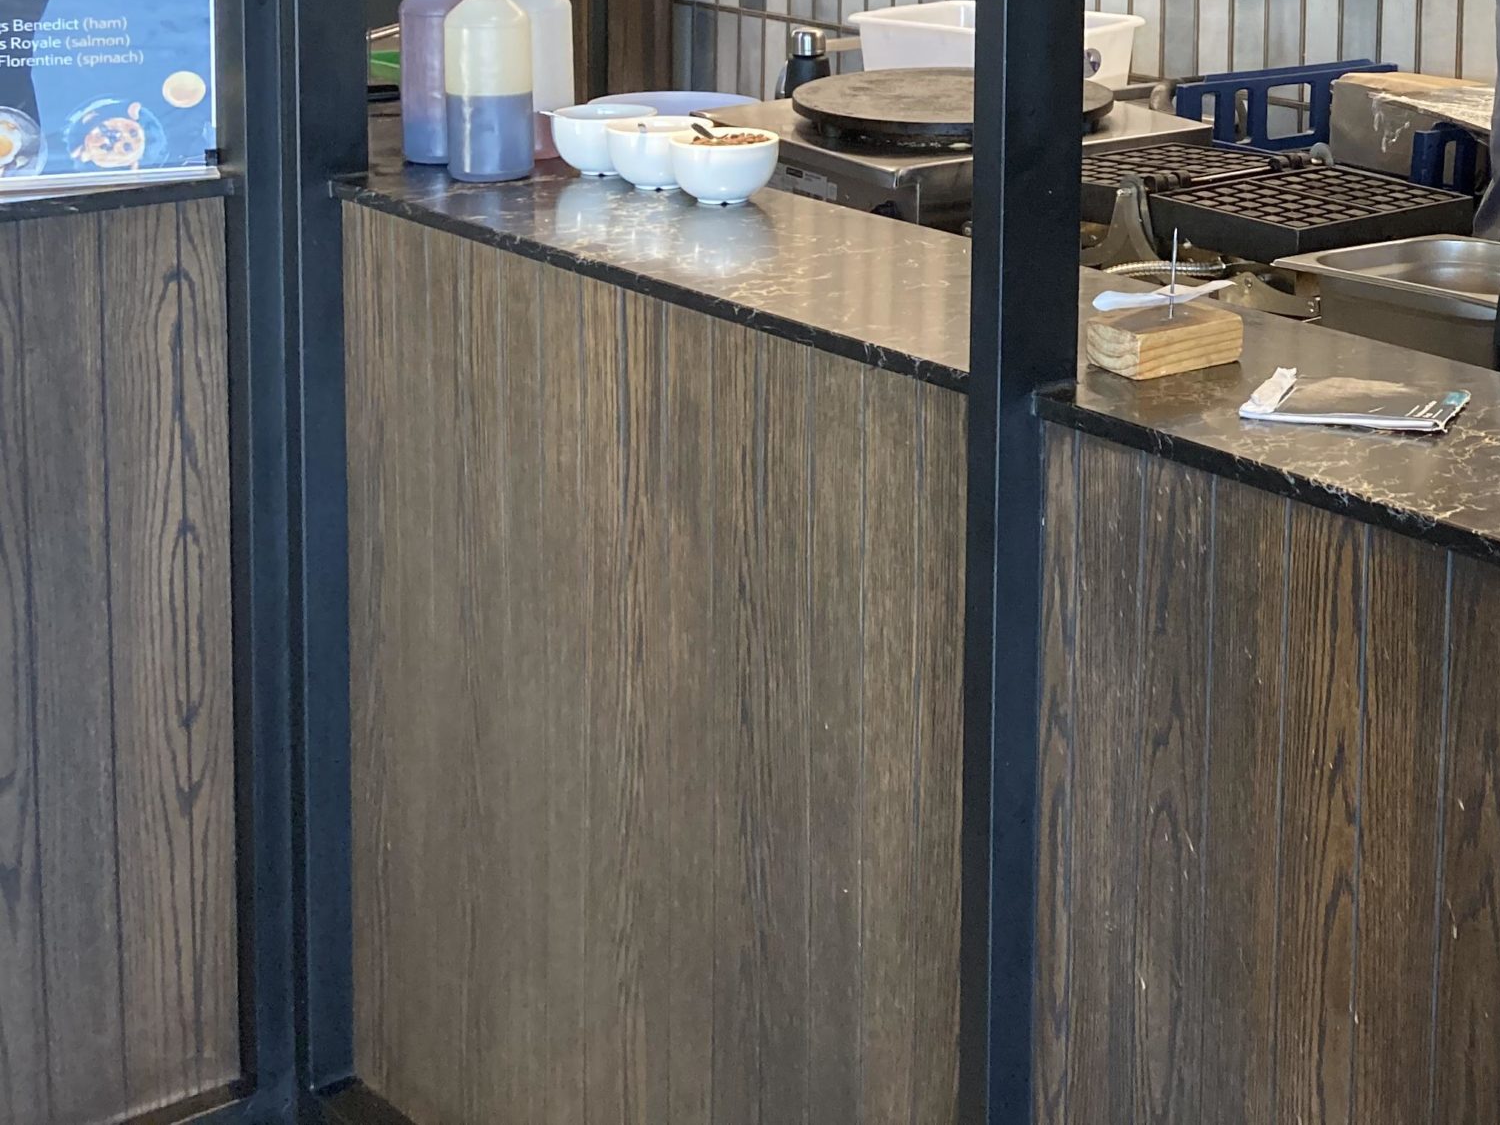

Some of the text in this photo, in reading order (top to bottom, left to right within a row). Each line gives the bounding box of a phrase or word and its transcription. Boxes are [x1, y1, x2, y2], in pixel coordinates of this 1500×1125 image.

[12, 17, 80, 33] Benedict
[83, 16, 128, 32] (ham)
[10, 36, 62, 52] Royale
[65, 34, 131, 51] (salmon)
[76, 50, 145, 68] (spinach)
